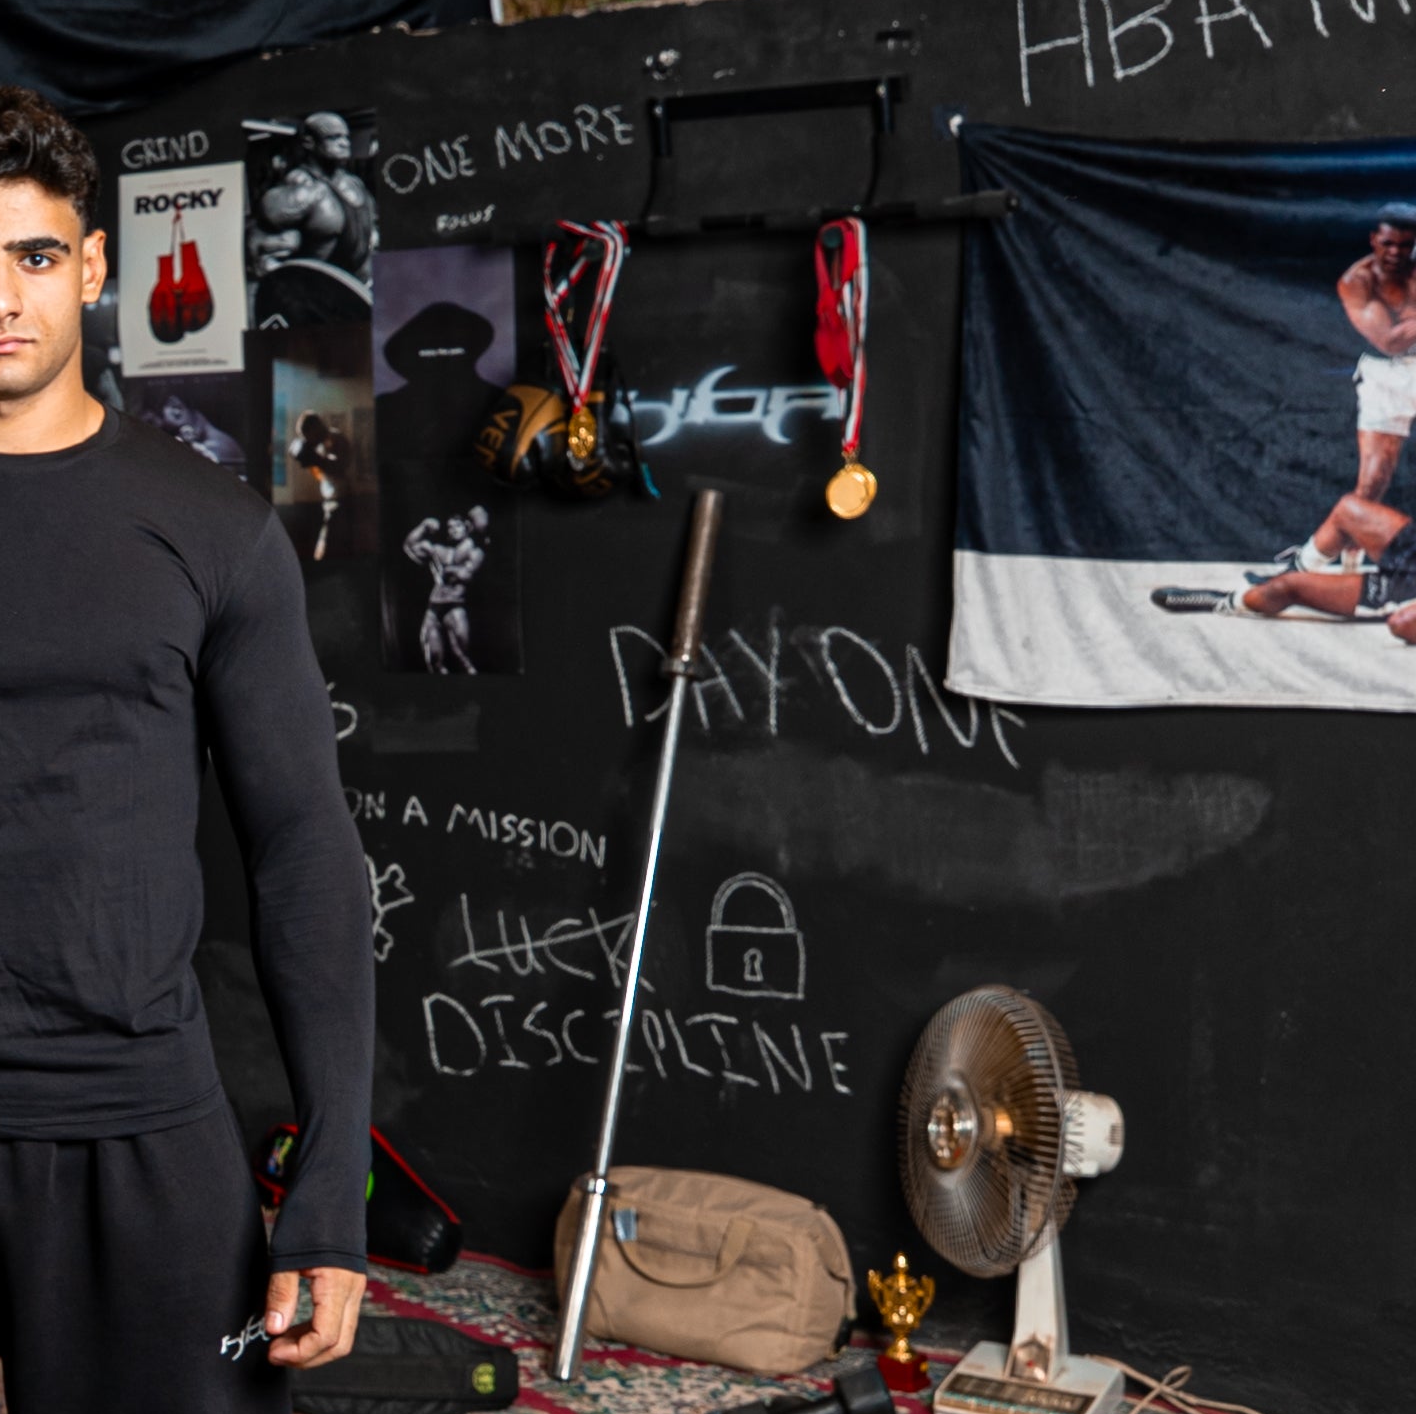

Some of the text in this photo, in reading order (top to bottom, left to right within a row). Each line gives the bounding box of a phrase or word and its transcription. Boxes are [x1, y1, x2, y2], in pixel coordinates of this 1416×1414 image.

[121, 129, 210, 169] GRIND
[383, 103, 634, 194] ONE MORE
[134, 186, 225, 216] ROCKY
[436, 203, 496, 232] FOCUS
[403, 795, 429, 827] A
[446, 803, 607, 869] MISSION
[449, 891, 657, 994] LUCK
[421, 991, 852, 1095] DISCIPLINE
